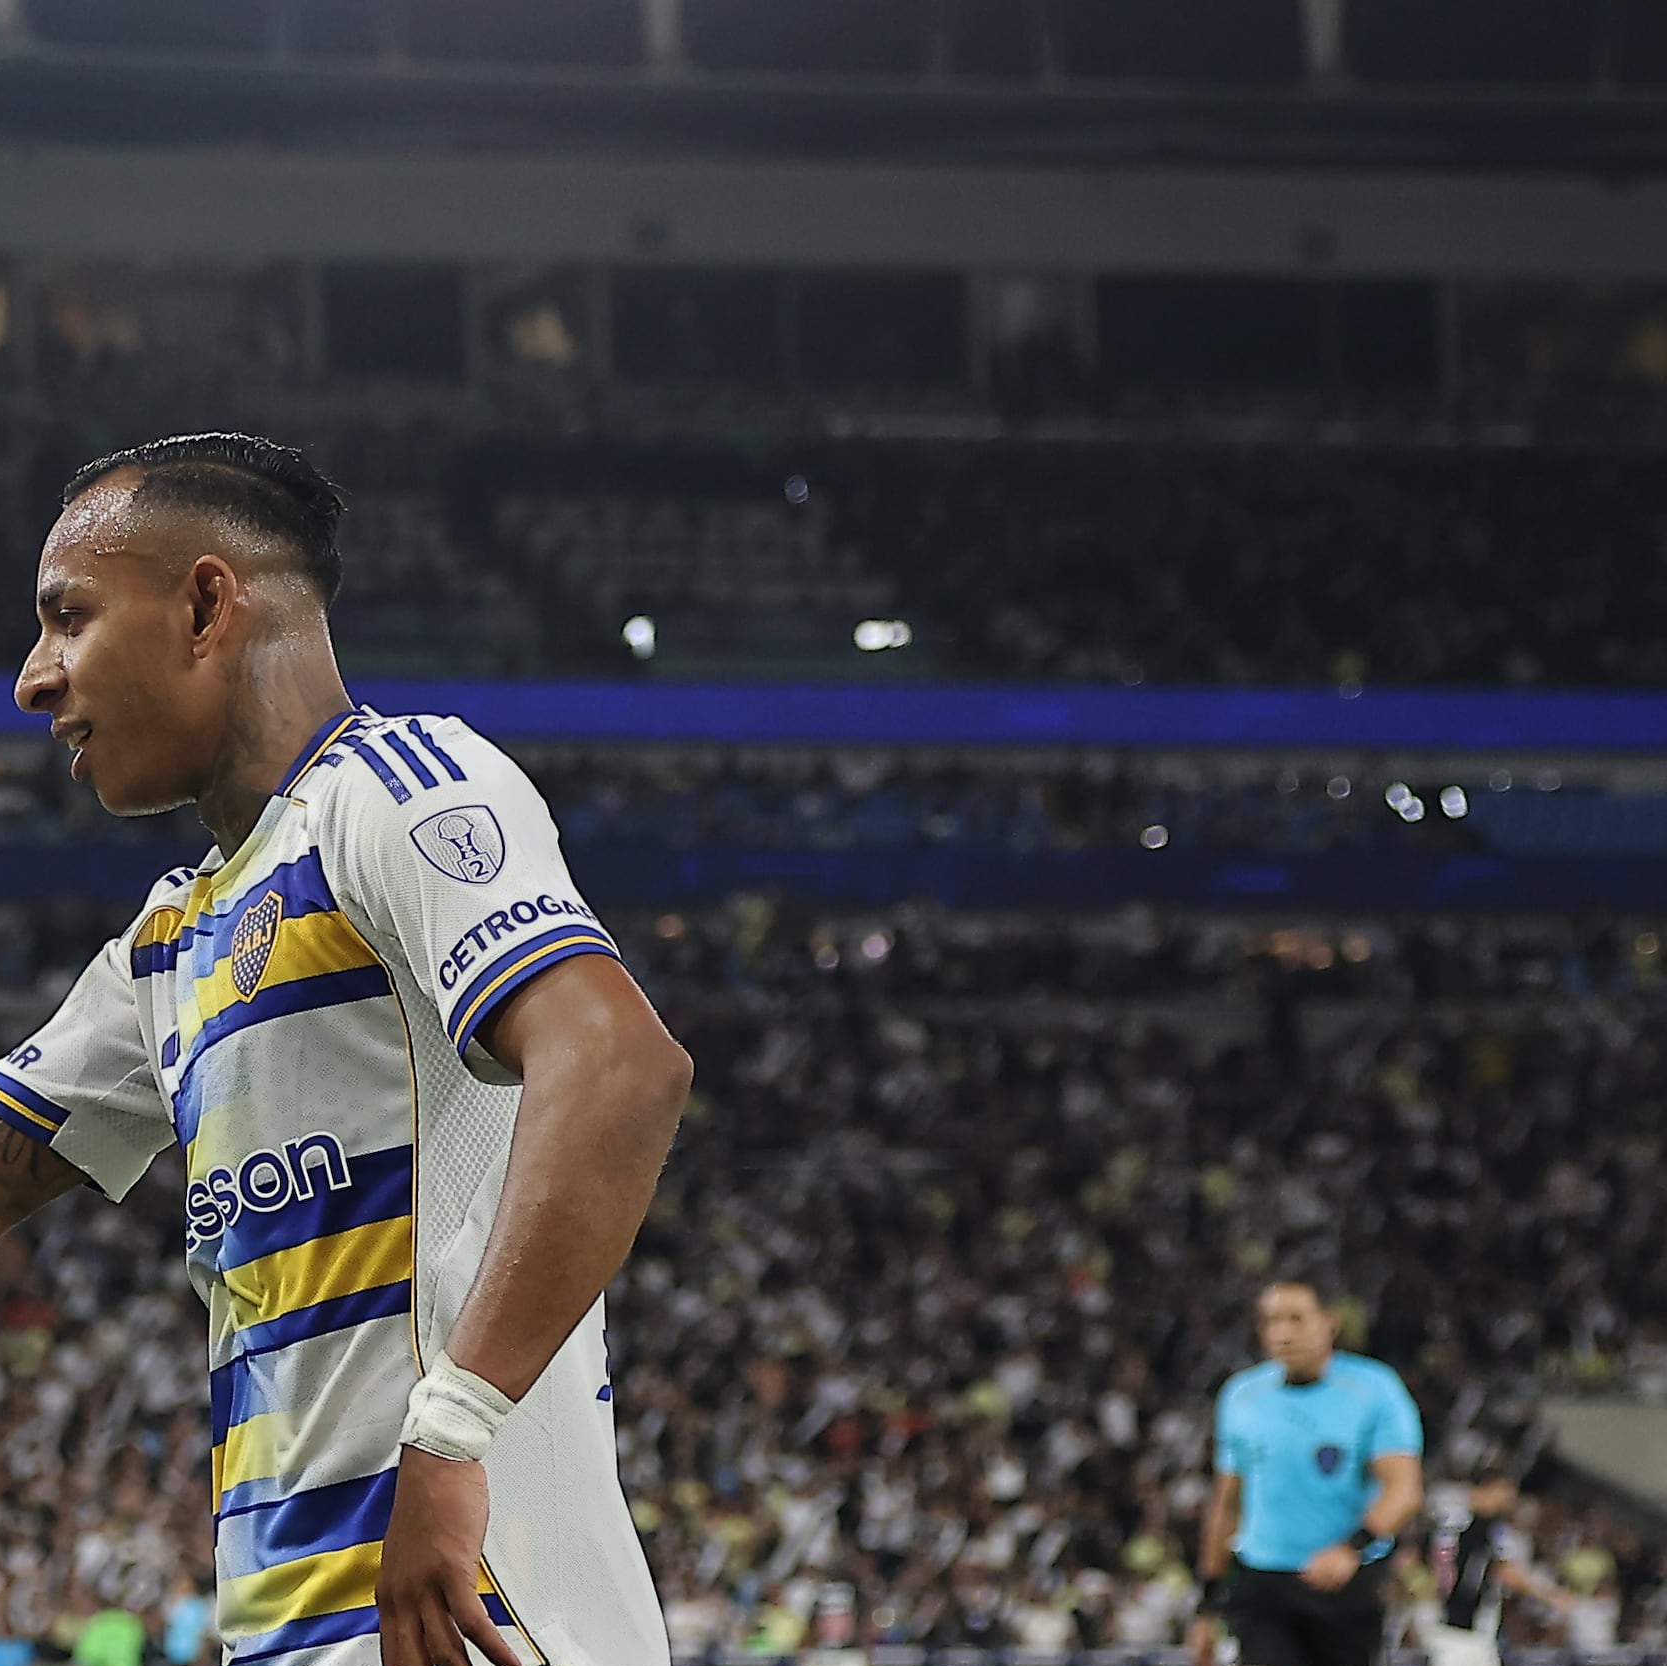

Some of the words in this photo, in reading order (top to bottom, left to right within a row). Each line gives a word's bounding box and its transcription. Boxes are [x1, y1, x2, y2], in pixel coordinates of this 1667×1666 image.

[469, 860, 489, 877] 2
[234, 922, 273, 962] CABJ
[187, 1131, 352, 1253] sson
